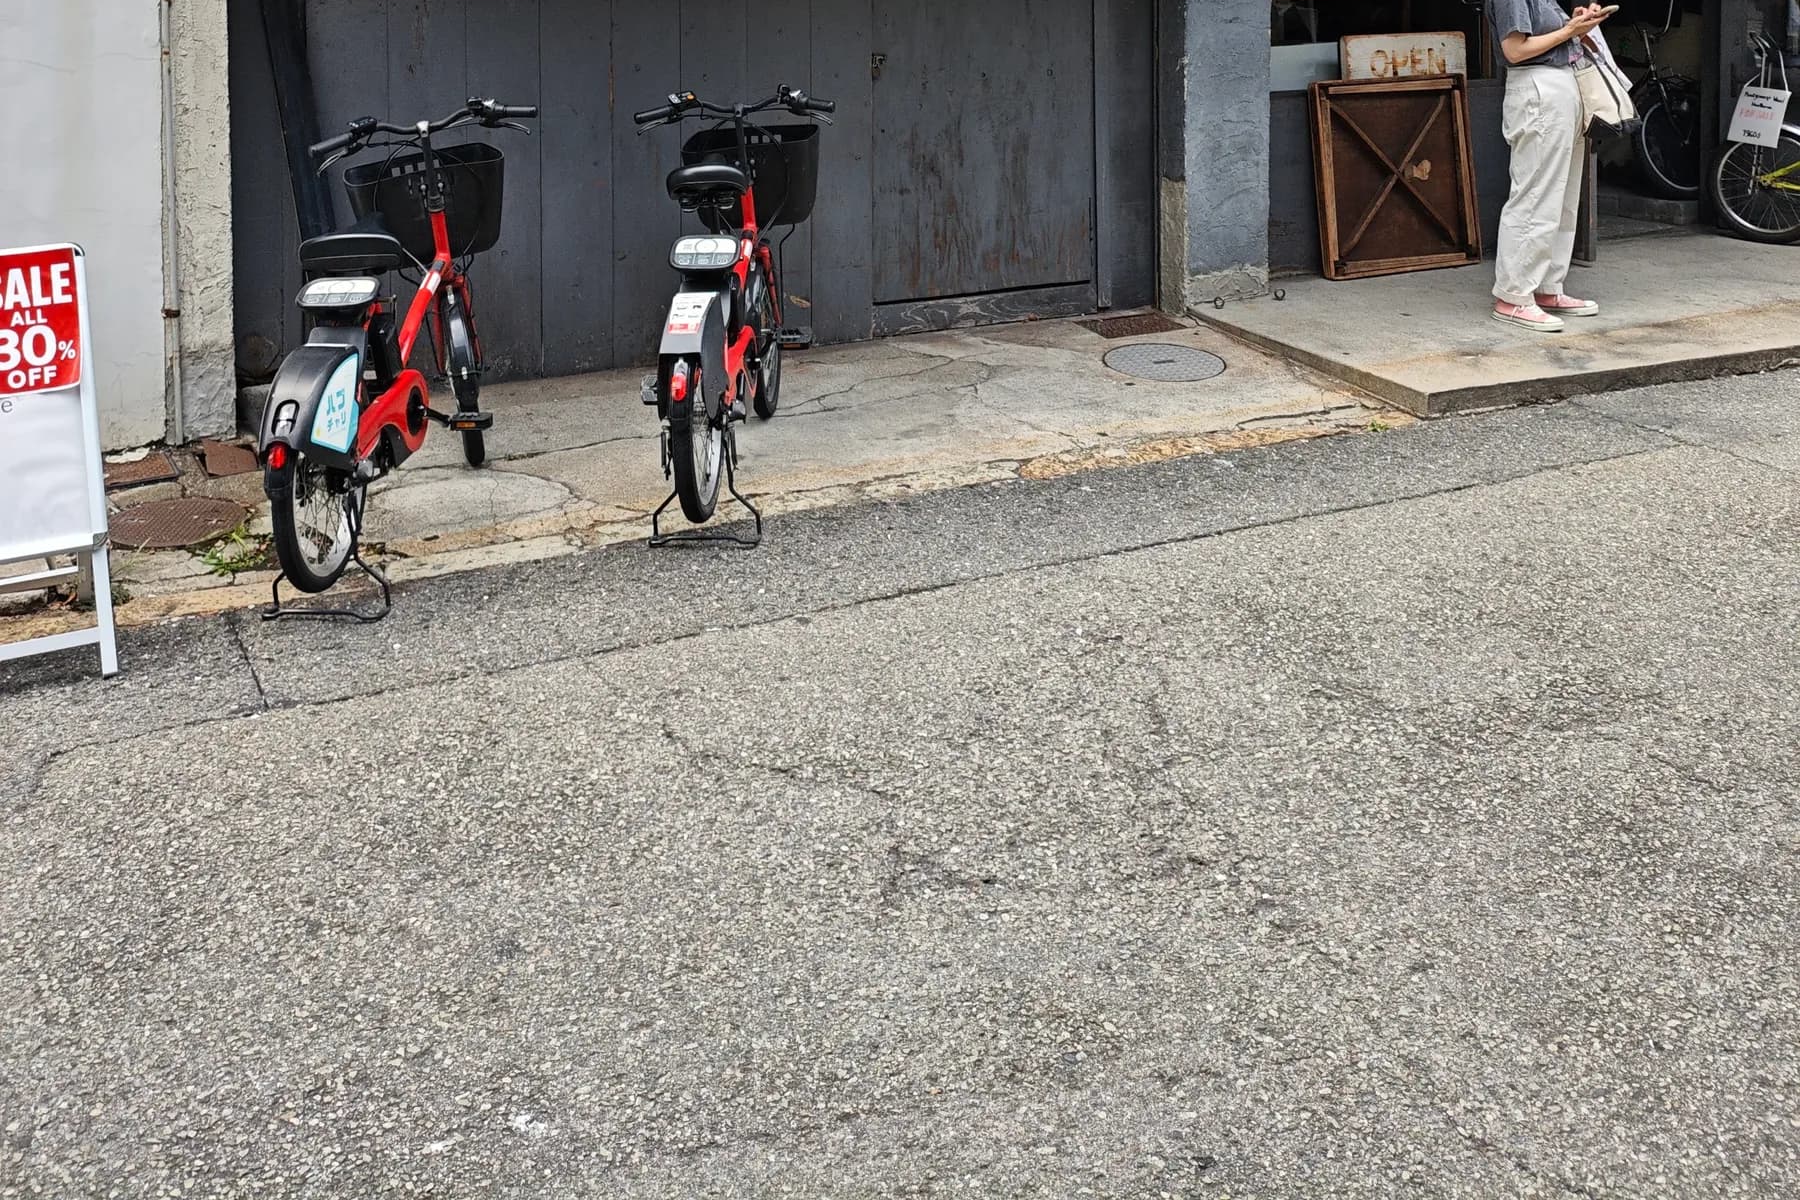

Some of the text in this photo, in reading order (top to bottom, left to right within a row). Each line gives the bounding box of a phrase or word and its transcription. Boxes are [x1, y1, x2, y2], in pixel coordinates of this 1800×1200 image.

[1369, 47, 1447, 78] OPEN
[0, 262, 73, 311] ALE
[10, 308, 48, 328] ALL
[7, 365, 58, 390] OFF
